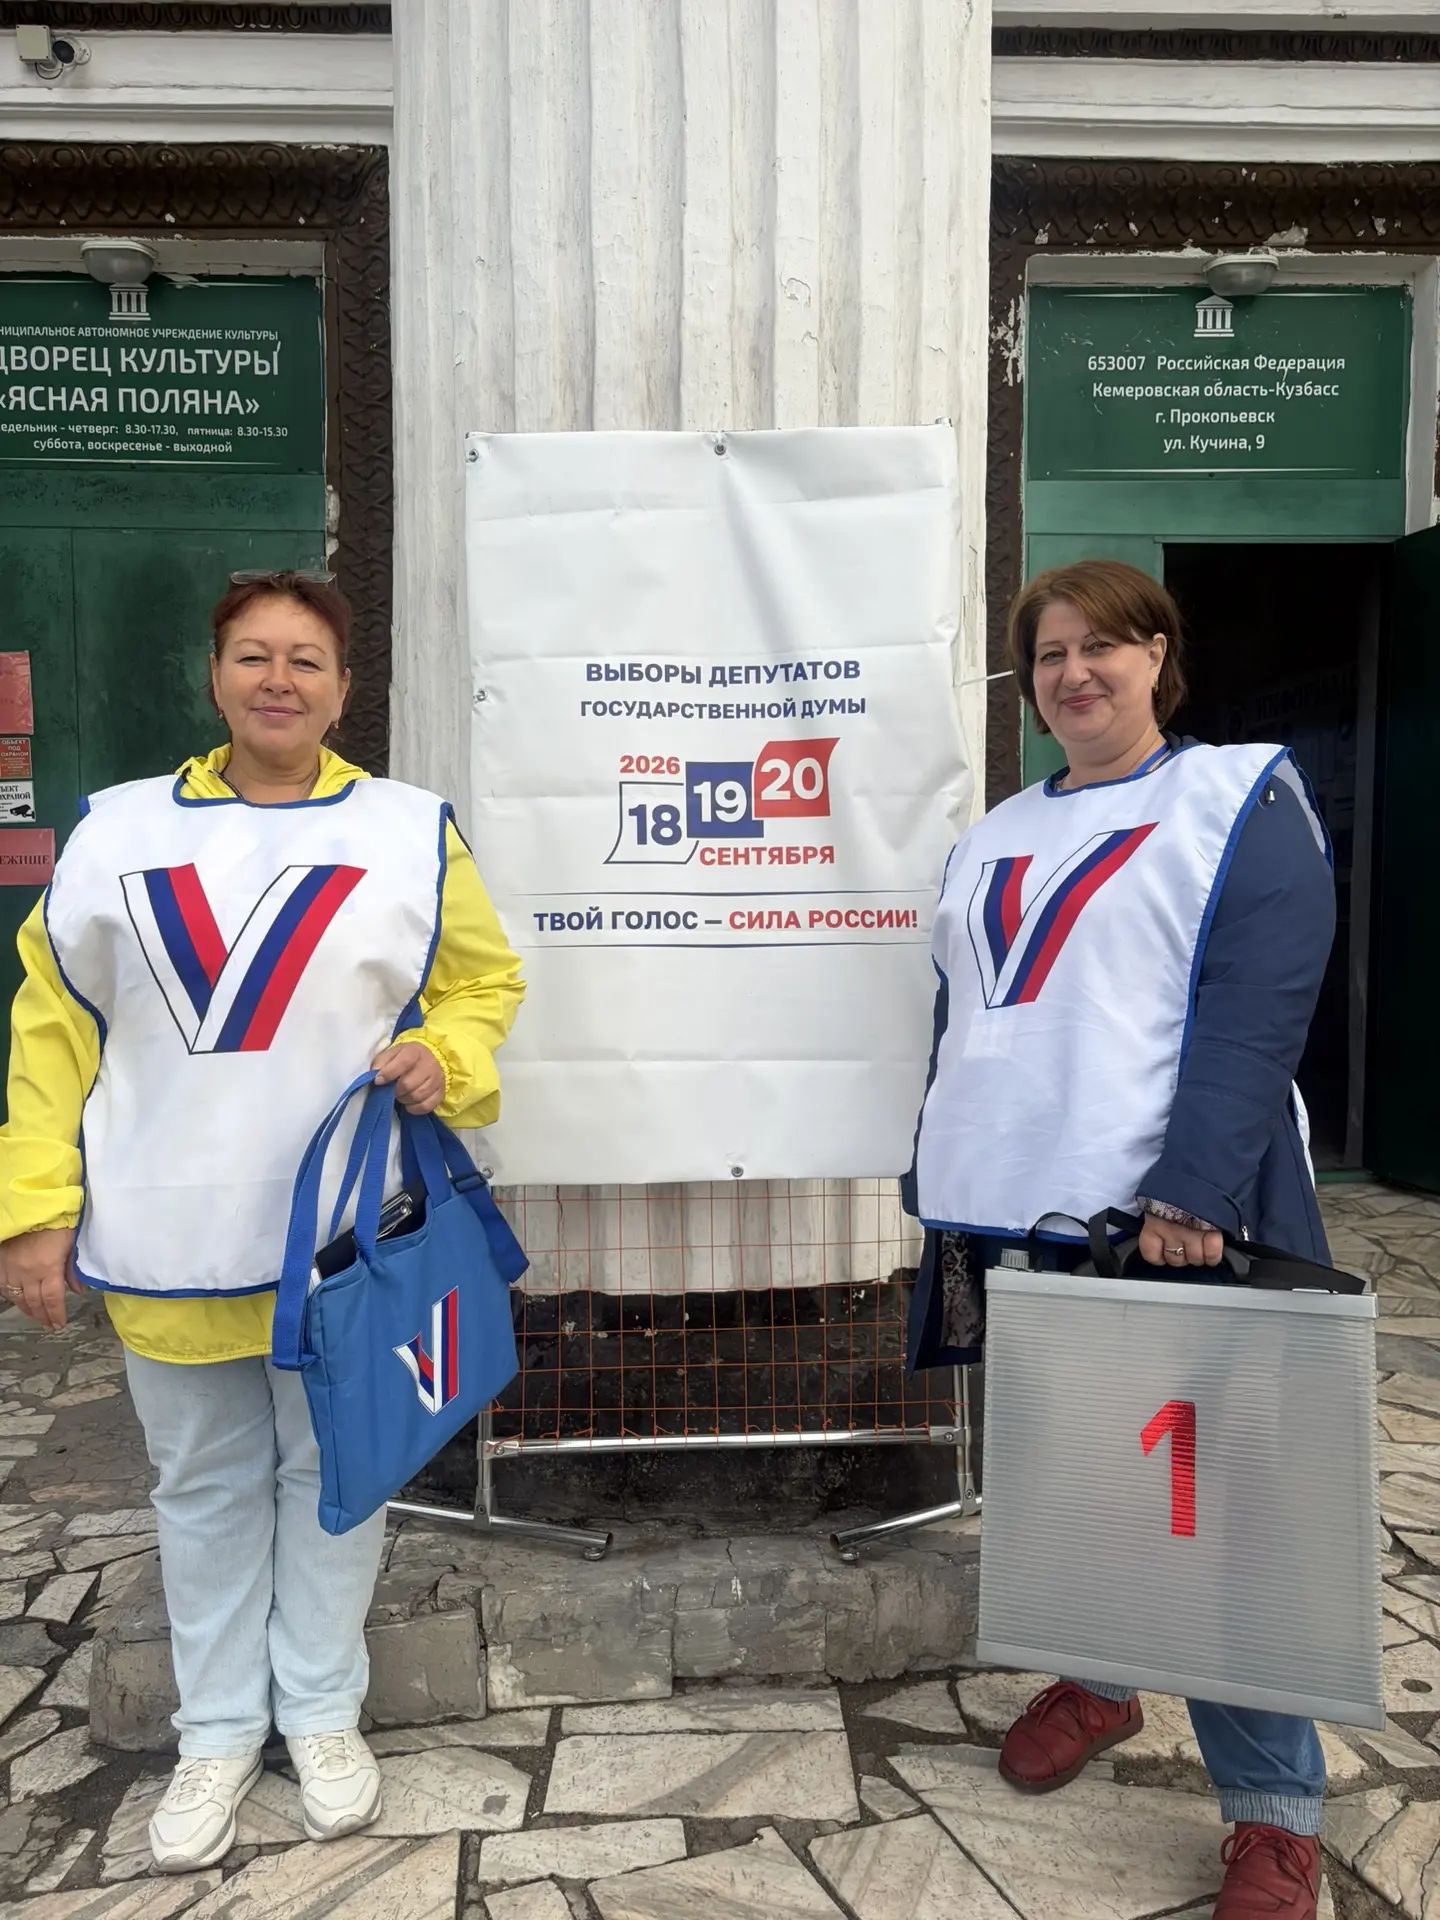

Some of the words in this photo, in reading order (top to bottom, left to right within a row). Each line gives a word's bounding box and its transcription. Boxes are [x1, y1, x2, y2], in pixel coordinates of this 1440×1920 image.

[77, 327, 150, 338] АВТОНОМНОЕ
[152, 328, 222, 340] УЧРЕЖДЕНИЕ
[224, 330, 278, 341] КУЛЬТУРЫ
[120, 347, 280, 376] КУЛЬТУРЫ
[1087, 356, 1146, 371] 653007
[1157, 354, 1250, 372] Российская
[1253, 355, 1345, 374] Федерация
[1092, 382, 1199, 400] Кемеровская
[1203, 380, 1340, 399] область-Кузбасс
[118, 387, 260, 415] ПОЛЯНА»
[1155, 410, 1166, 424] г.
[1170, 408, 1275, 427] Прокопьевск
[68, 424, 119, 436] четверг:
[125, 424, 179, 436] 8.30-17.30,
[187, 427, 233, 437] пятница:
[237, 426, 288, 437] 8.30-15.30
[33, 438, 85, 451] суббота,
[87, 440, 163, 453] воскресенье
[173, 441, 233, 454] выходной
[1163, 436, 1186, 454] ул.
[1190, 435, 1252, 453] Кучина,
[1255, 434, 1265, 450] 9
[586, 662, 701, 683] ВЫБОРЫ
[708, 660, 861, 688] ДЕПУТАТОВ
[580, 698, 797, 720] ГОСУДАРСТВЕННОЙ
[800, 697, 866, 720] ДУМЫ
[619, 755, 681, 775] 2026
[627, 803, 683, 846] 18
[692, 780, 748, 824] 19
[759, 757, 825, 801] 20
[699, 844, 836, 867] СЕНТЯБРЯ
[533, 906, 603, 931] ТВОЙ
[611, 910, 699, 931] ГОЛОС
[728, 910, 802, 931] СИЛА
[808, 909, 919, 930] РОССИИ!
[1140, 1400, 1197, 1538] 1
